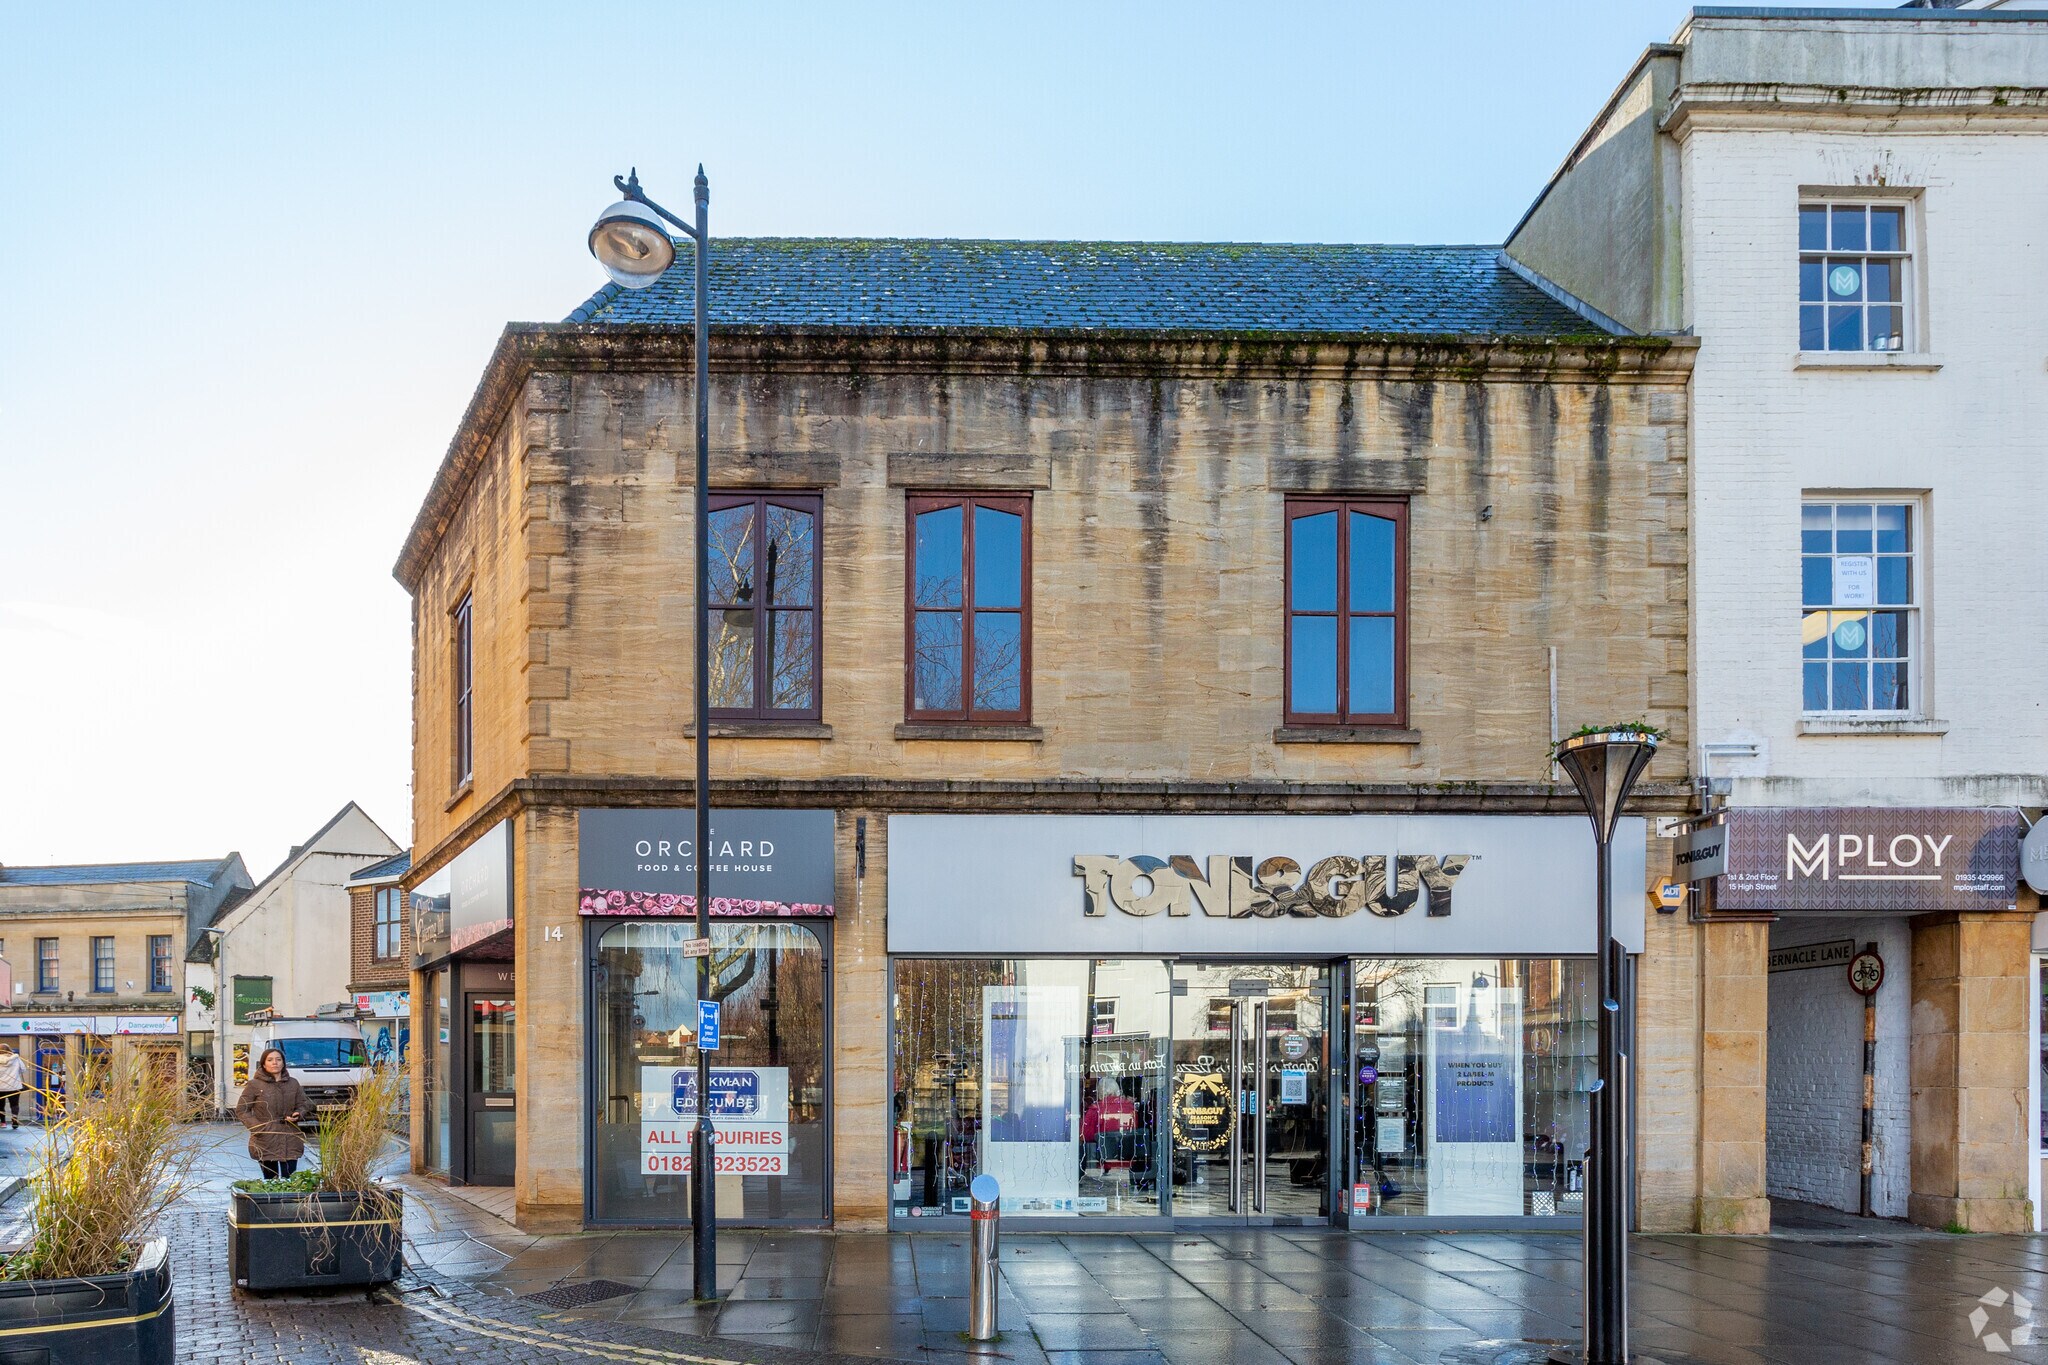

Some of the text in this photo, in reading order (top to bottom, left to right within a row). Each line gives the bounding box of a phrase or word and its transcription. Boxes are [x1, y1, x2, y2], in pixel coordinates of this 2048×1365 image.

[1676, 844, 1722, 866] TONI&GUY
[637, 864, 772, 872] FOOD & CFEE HOUSE
[1727, 873, 1778, 881] 1st & 2nd Floor
[1074, 854, 1471, 918] TONI&GUY
[1663, 885, 1680, 895] ADT
[1738, 883, 1755, 892] High
[1755, 883, 1777, 891] Street
[544, 926, 564, 942] 14
[1821, 946, 1850, 961] LANE
[678, 1077, 752, 1087] LAKMAN
[648, 1131, 782, 1144] ALL EQUIRIES
[648, 1156, 781, 1171] 0182 323523
